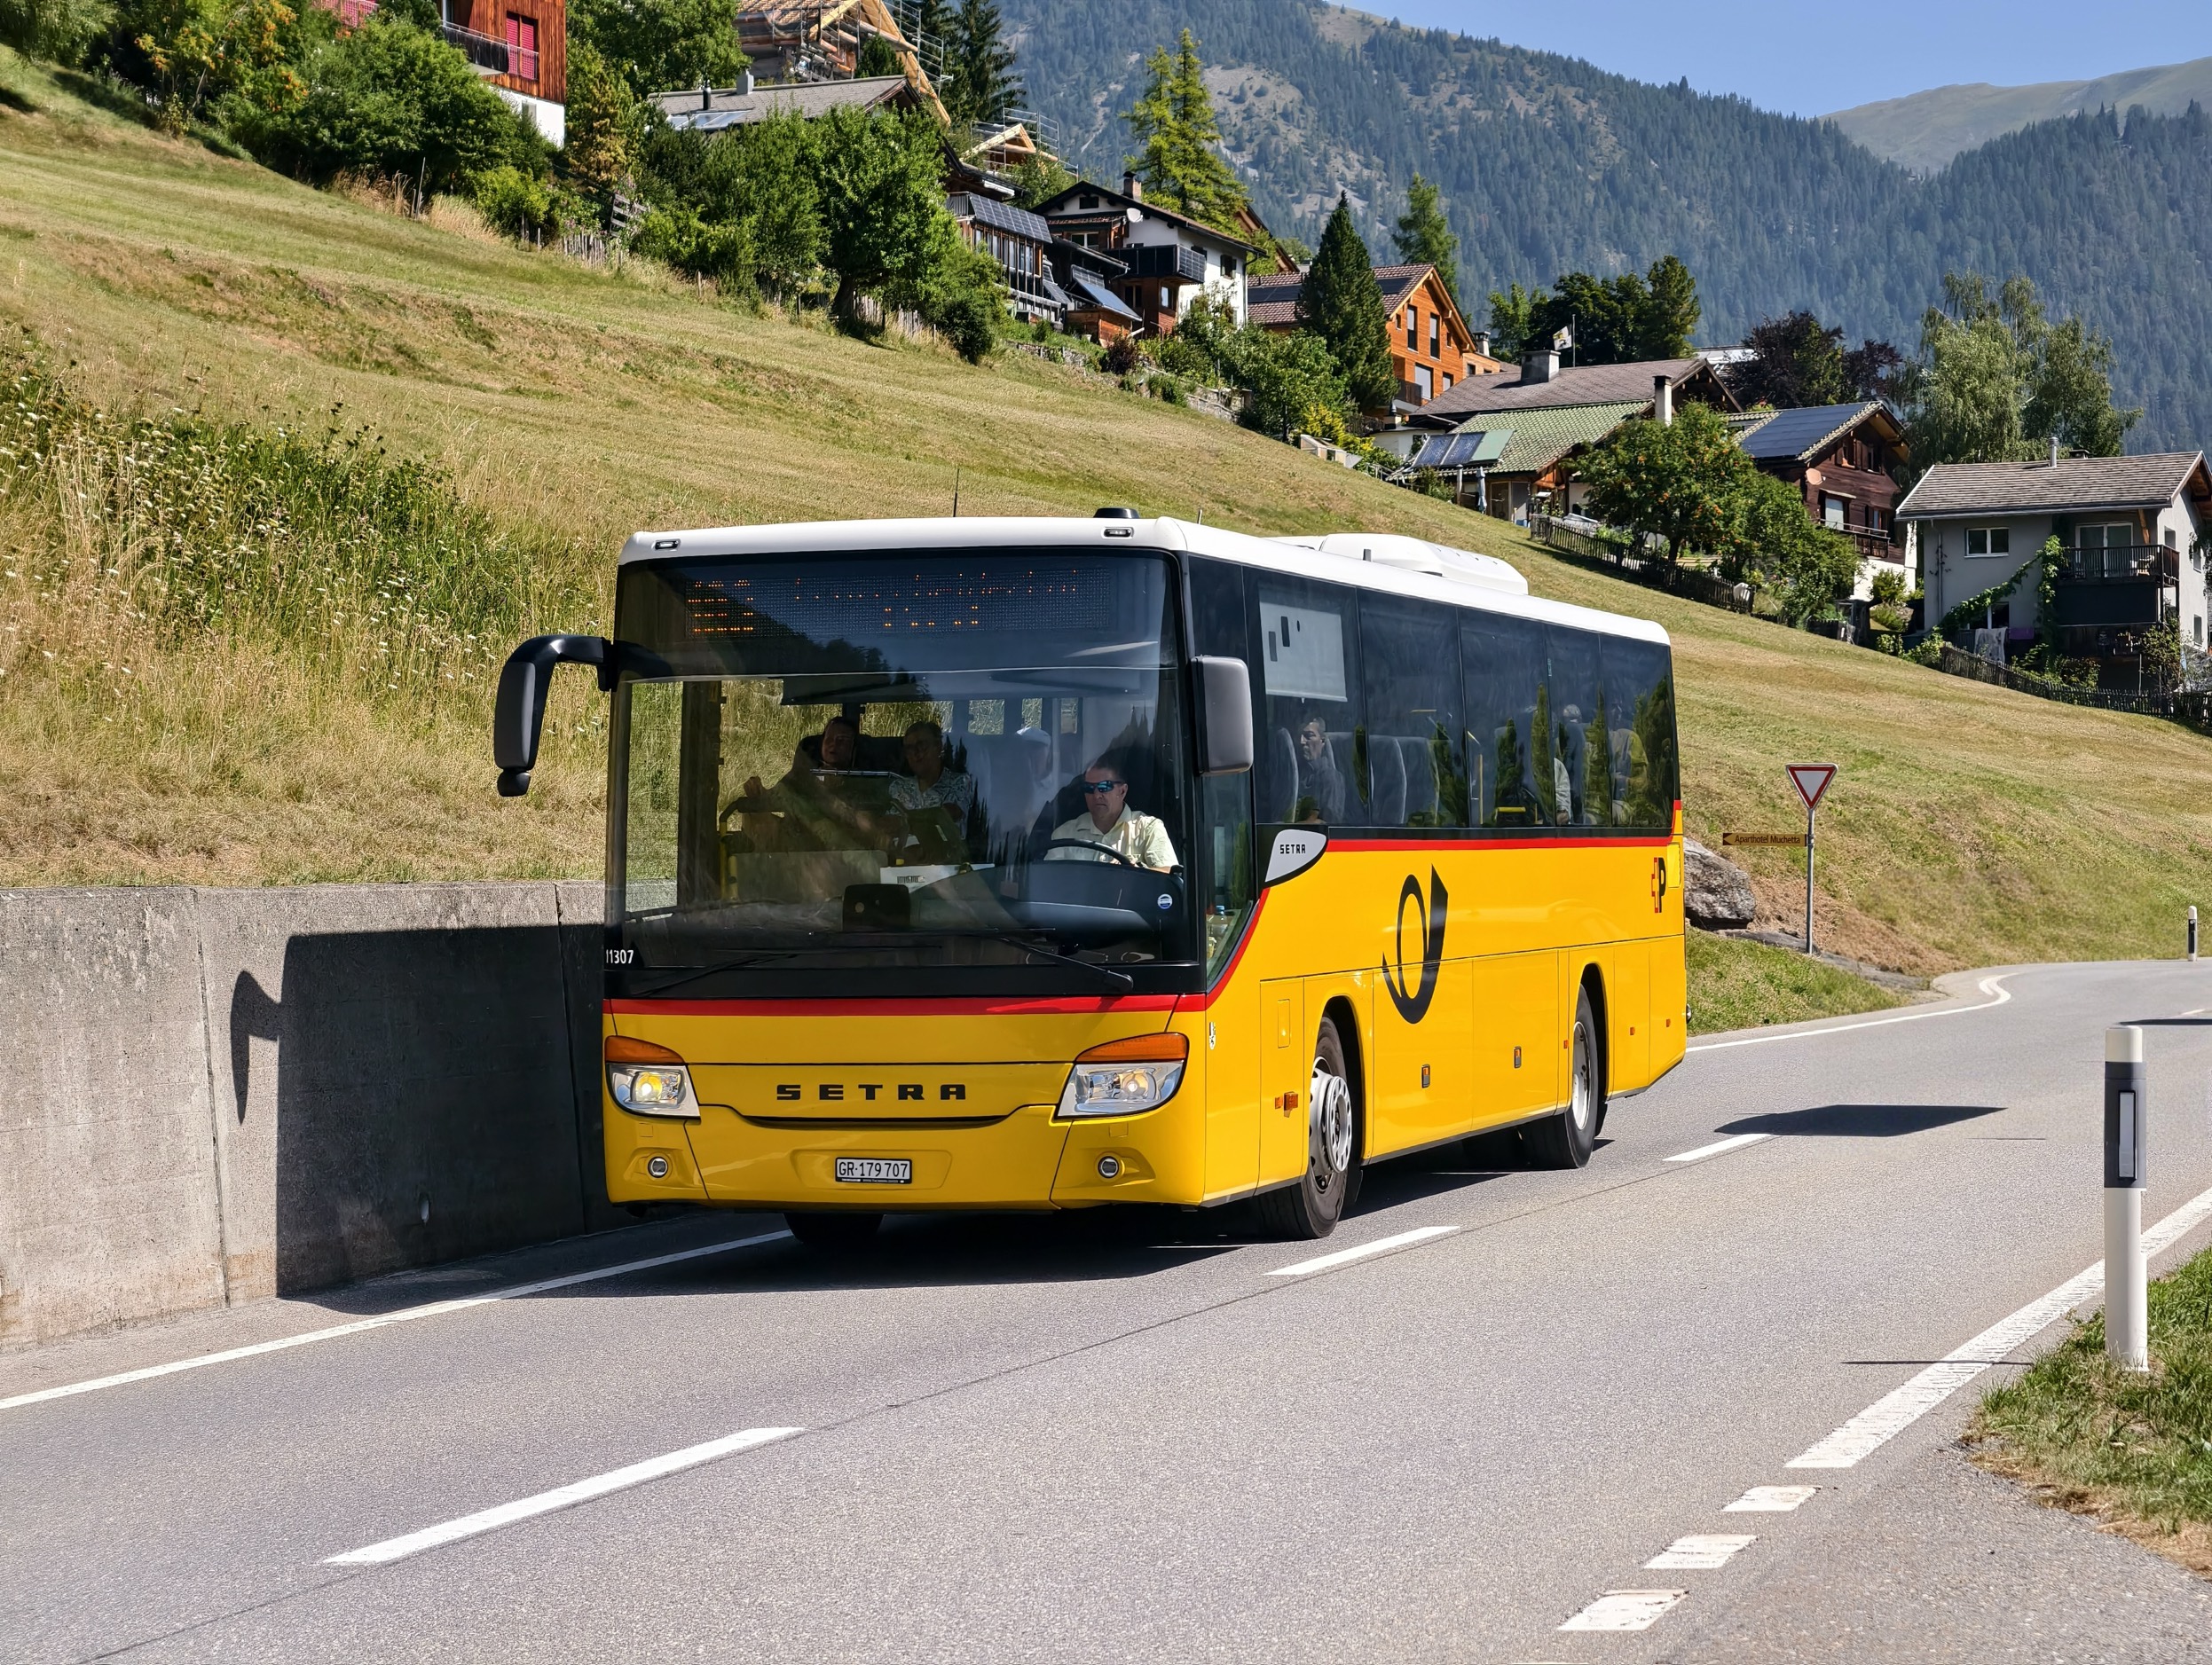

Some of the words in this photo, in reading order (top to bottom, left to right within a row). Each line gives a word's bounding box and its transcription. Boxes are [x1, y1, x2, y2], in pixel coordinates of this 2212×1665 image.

[1735, 835, 1768, 844] Aparthotel
[1770, 835, 1800, 844] Muchetta
[1279, 844, 1306, 854] SETRA
[606, 949, 634, 964] 11307
[776, 1084, 966, 1101] SETRA
[884, 1162, 909, 1178] 707
